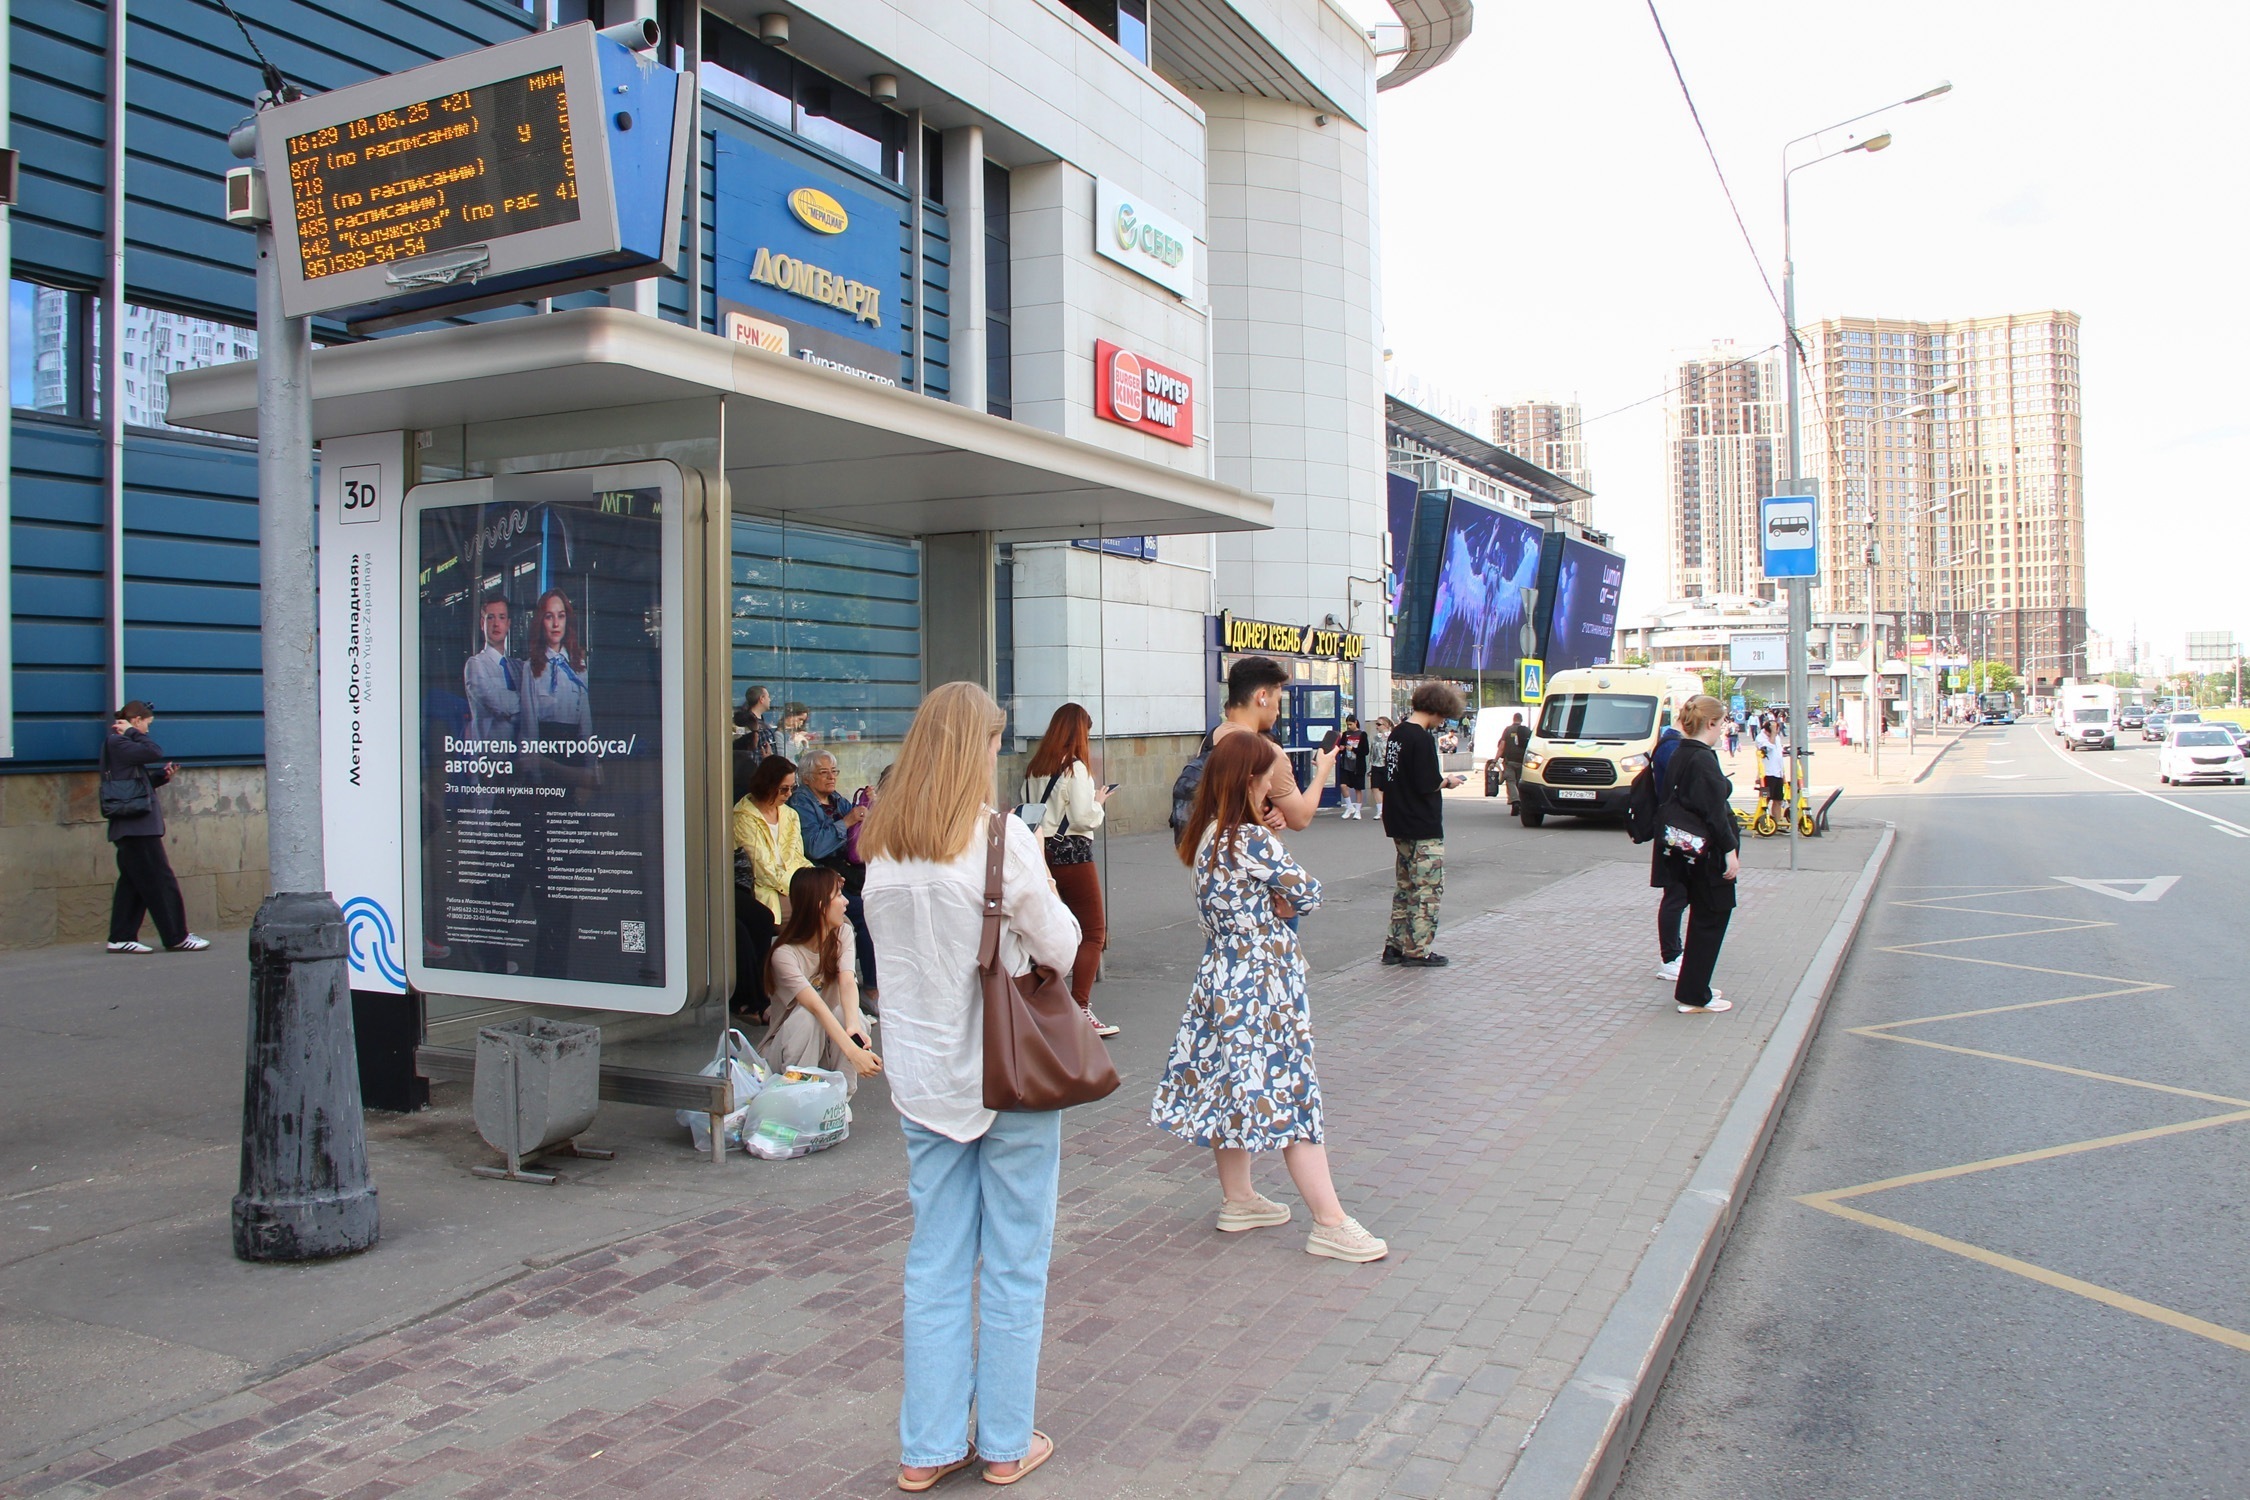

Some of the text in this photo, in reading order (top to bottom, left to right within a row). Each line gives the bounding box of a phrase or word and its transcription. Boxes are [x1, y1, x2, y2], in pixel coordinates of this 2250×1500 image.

[291, 126, 338, 155] 16:29
[349, 102, 429, 139] 10.06.25
[442, 91, 472, 111] +21
[291, 157, 319, 179] 877
[328, 152, 357, 170] (по
[293, 177, 323, 199] 718
[297, 198, 324, 220] 281
[332, 193, 362, 210] (по
[302, 237, 331, 259] 642
[462, 204, 494, 222] (по
[504, 192, 539, 213] рас
[556, 180, 578, 200] 41
[299, 217, 329, 238] 485
[1141, 223, 1184, 268] СБЕР
[750, 247, 881, 328] ЛОМБАРД
[736, 323, 759, 346] FUN
[1115, 369, 1140, 391] BURGER
[1146, 368, 1189, 405] БУРГЕР
[1115, 383, 1140, 409] KING
[1147, 395, 1178, 428] КИНГ
[343, 481, 375, 511] 3D
[600, 492, 634, 515] МГТ
[363, 552, 373, 702] Metro Yugo-Zapadnaya
[1232, 620, 1268, 652] ДОНЕР
[1269, 625, 1301, 653] КЕБАБ
[348, 553, 362, 787] Метро «Юго-Западная»
[445, 734, 636, 758] Водитель электробуса/
[445, 757, 513, 778] автобуса
[445, 783, 566, 797] Эта профессия нужна городу
